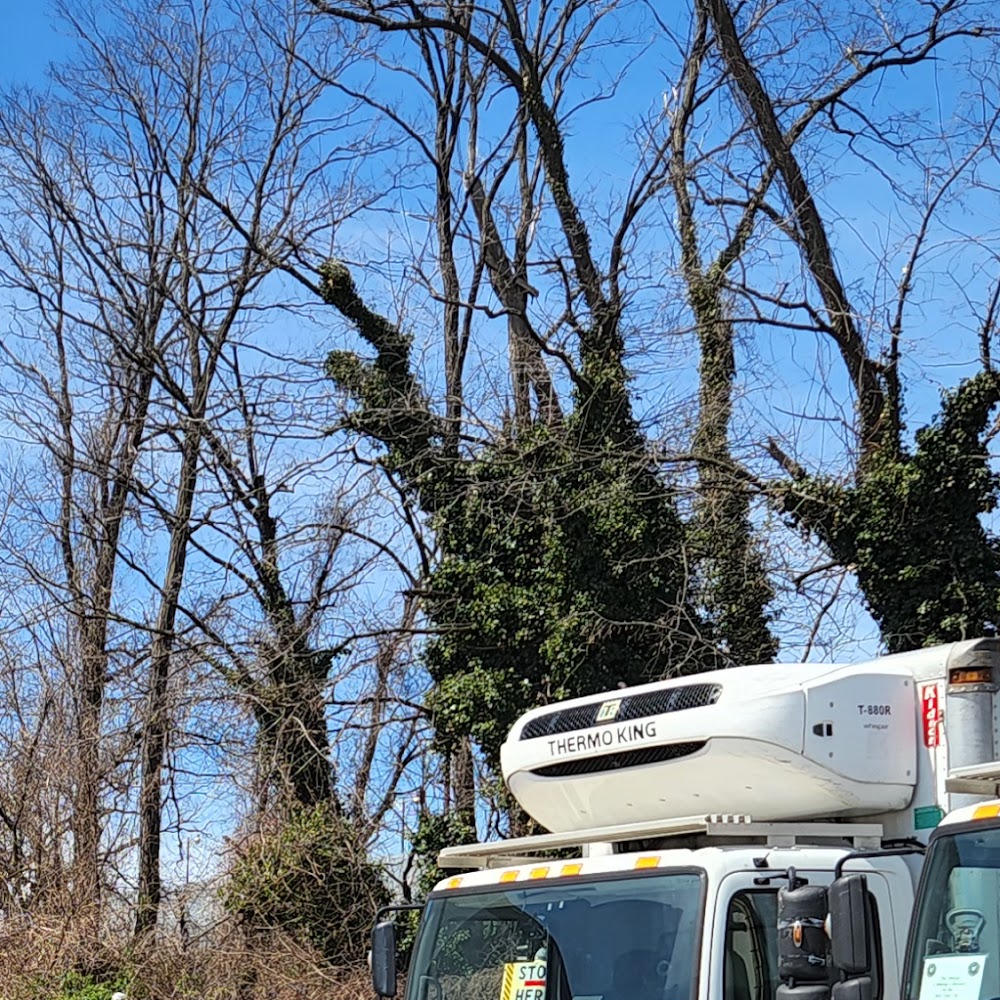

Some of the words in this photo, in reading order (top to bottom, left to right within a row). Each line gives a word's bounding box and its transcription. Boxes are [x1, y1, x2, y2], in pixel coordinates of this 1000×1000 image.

[857, 705, 891, 715] T-880R
[547, 730, 613, 756] THERMO
[617, 721, 657, 743] KING
